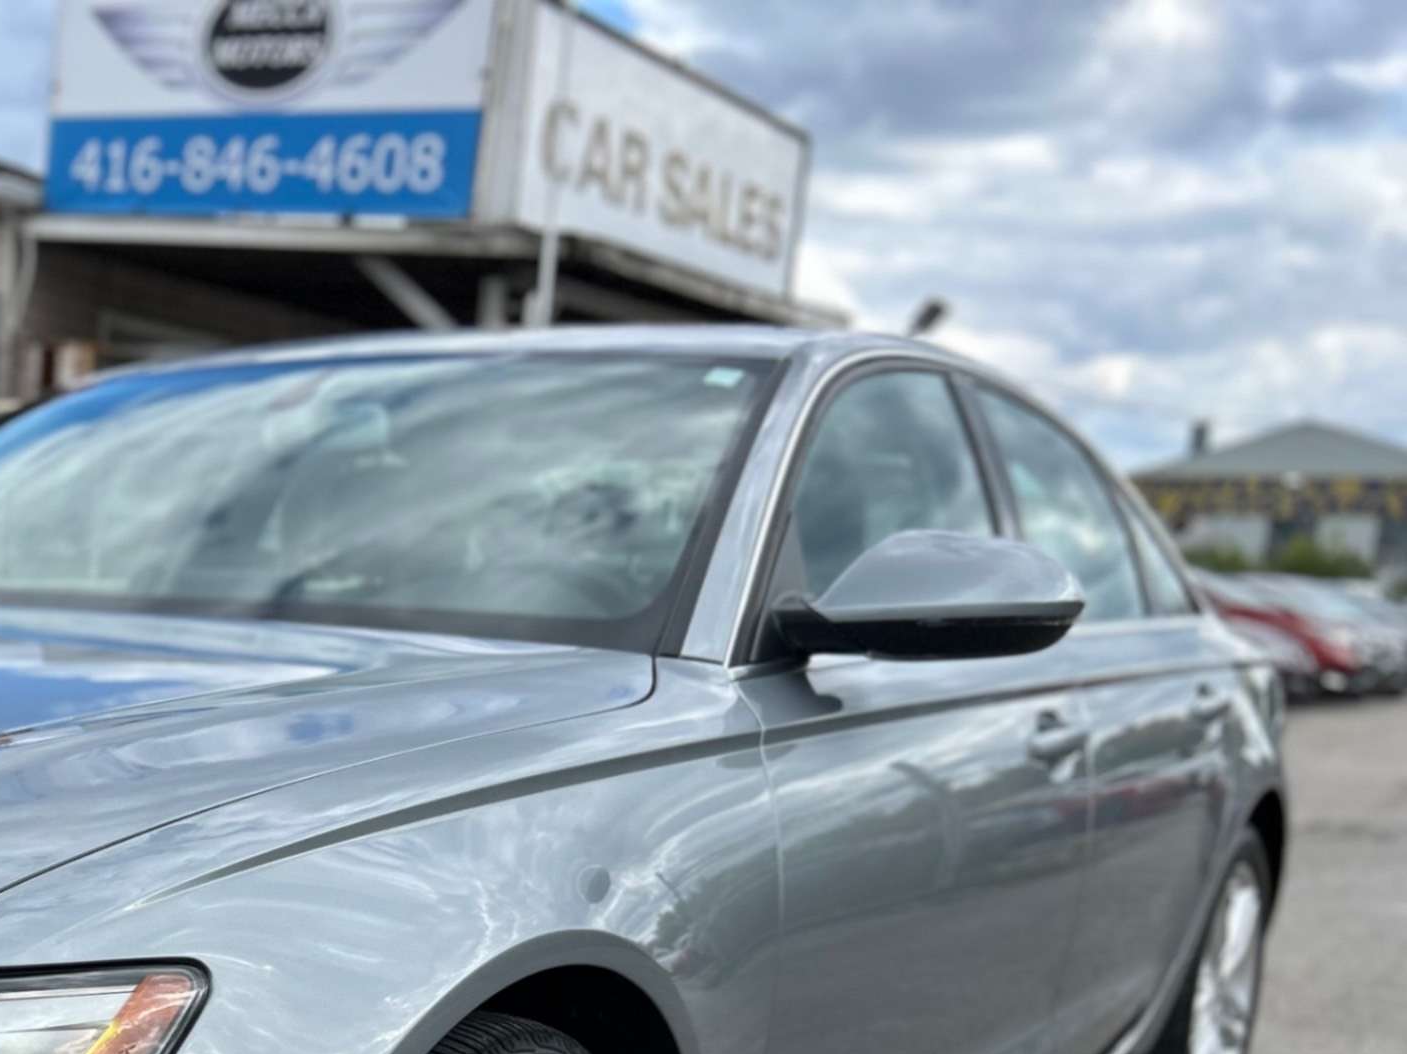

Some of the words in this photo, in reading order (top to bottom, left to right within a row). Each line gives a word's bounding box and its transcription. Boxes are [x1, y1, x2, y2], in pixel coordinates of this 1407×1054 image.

[212, 33, 326, 69] MOTORS
[70, 131, 446, 194] 416-846-4608
[539, 99, 650, 217] CAR
[658, 146, 784, 261] SALES
